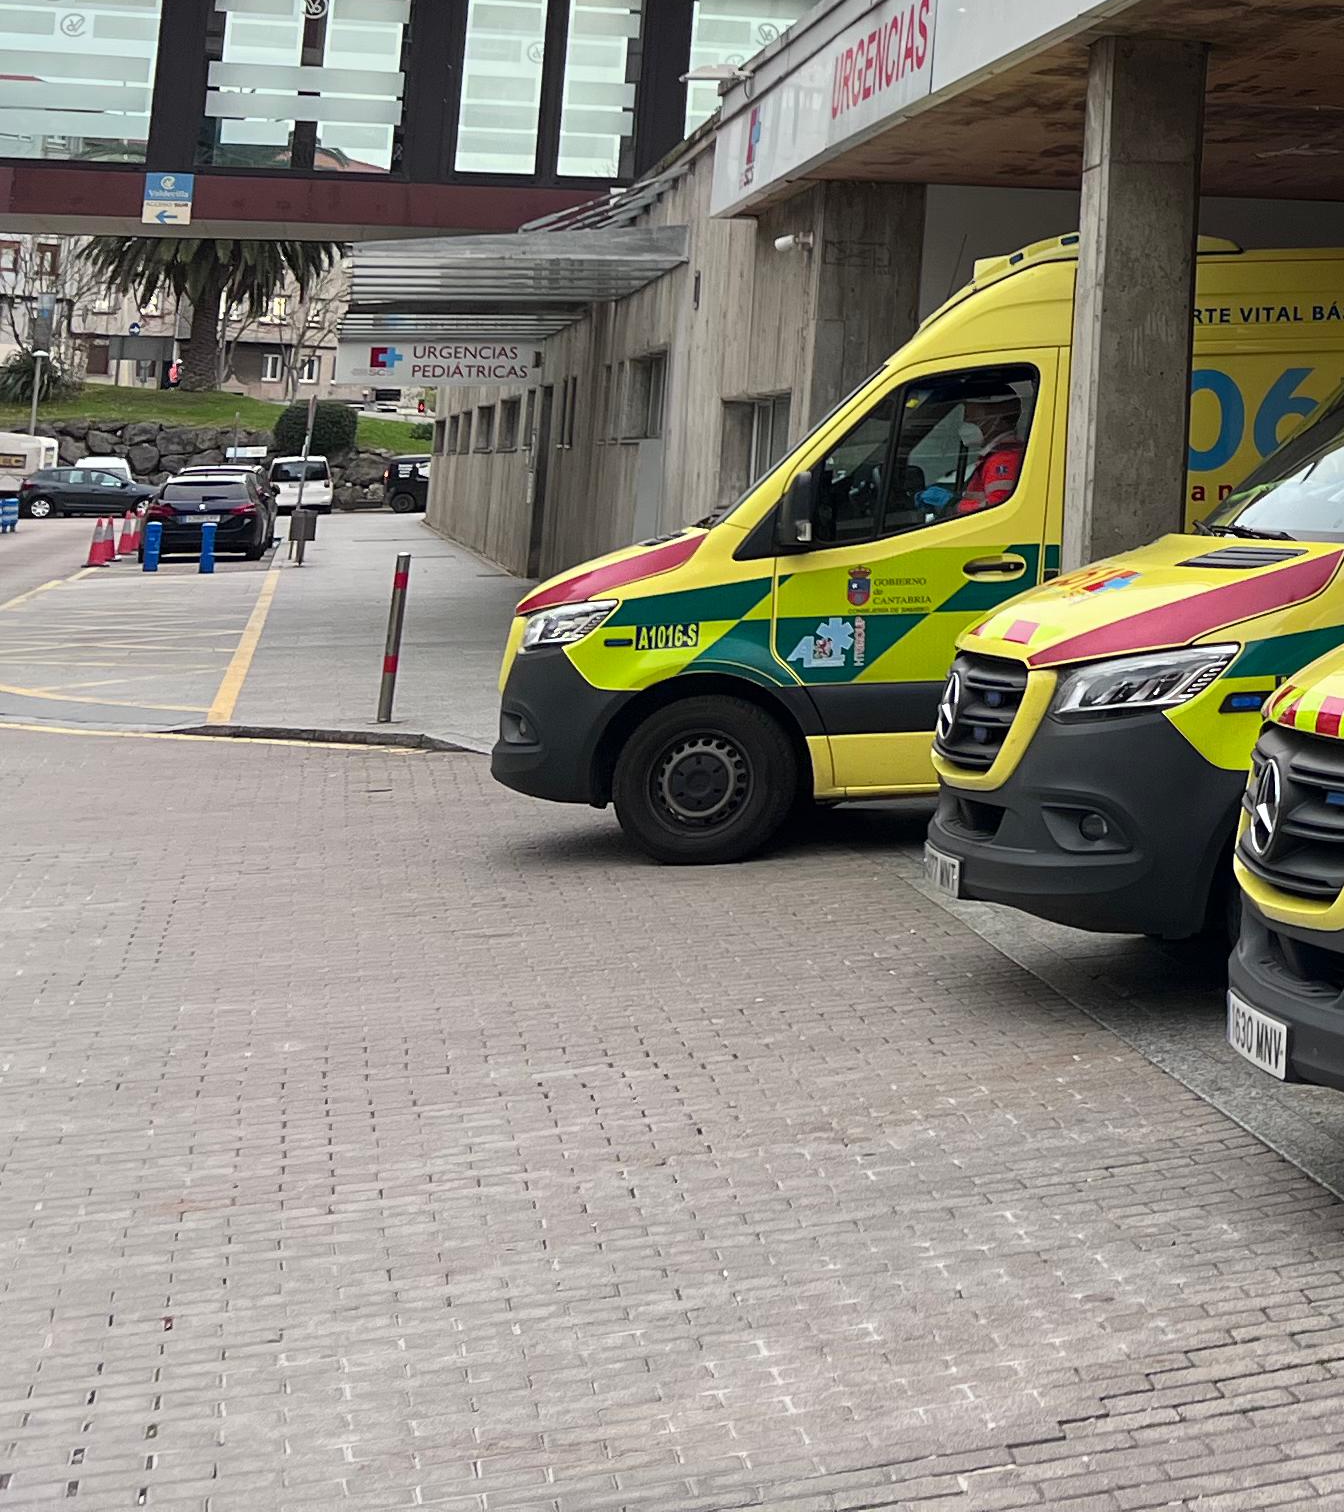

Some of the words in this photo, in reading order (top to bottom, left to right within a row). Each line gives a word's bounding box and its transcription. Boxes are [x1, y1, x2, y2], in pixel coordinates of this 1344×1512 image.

[1240, 305, 1303, 322] VITAL
[413, 345, 518, 360] URGENCIAS
[411, 362, 529, 378] PEDIÁTRICAS
[873, 577, 927, 586] GOBIERNO
[873, 596, 932, 605] CANTABRIA
[638, 623, 697, 649] A1016-S
[1256, 1020, 1282, 1069] MNV
